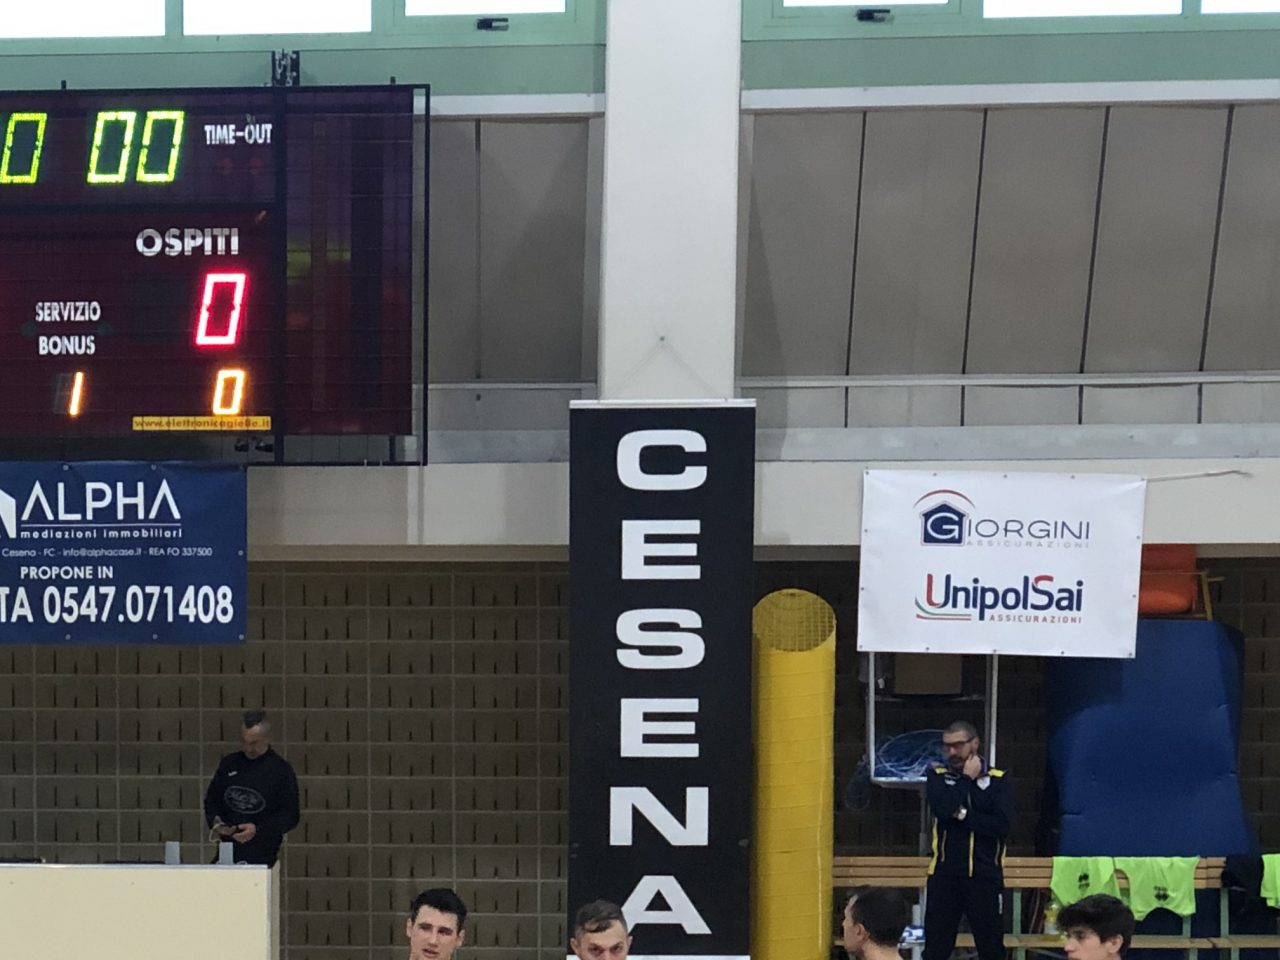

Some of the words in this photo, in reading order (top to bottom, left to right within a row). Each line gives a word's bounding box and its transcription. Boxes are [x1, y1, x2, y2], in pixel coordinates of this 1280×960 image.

[87, 111, 185, 183] 00
[204, 124, 272, 144] TIME-OUT
[136, 228, 239, 256] OSPITI
[35, 301, 101, 321] SERVIZIO
[195, 273, 246, 345] 0
[38, 336, 96, 355] BONUS
[212, 369, 245, 415] 0
[21, 478, 181, 520] ALPHA
[21, 529, 97, 539] mediazioni
[103, 528, 182, 538] immobiliari
[926, 512, 1091, 540] GIORGINI
[43, 548, 56, 556] FC
[149, 547, 165, 556] REA
[167, 547, 180, 556] FO
[181, 547, 213, 556] 337500
[966, 540, 1090, 549] ASSICURAZIONI
[21, 566, 93, 580] PROPONE
[97, 566, 113, 579] IN
[42, 585, 234, 624] 0547.071408
[926, 573, 1084, 621] UnipolSai
[989, 614, 1082, 624] ASSICURAZIONI
[609, 429, 712, 935] CESENA
